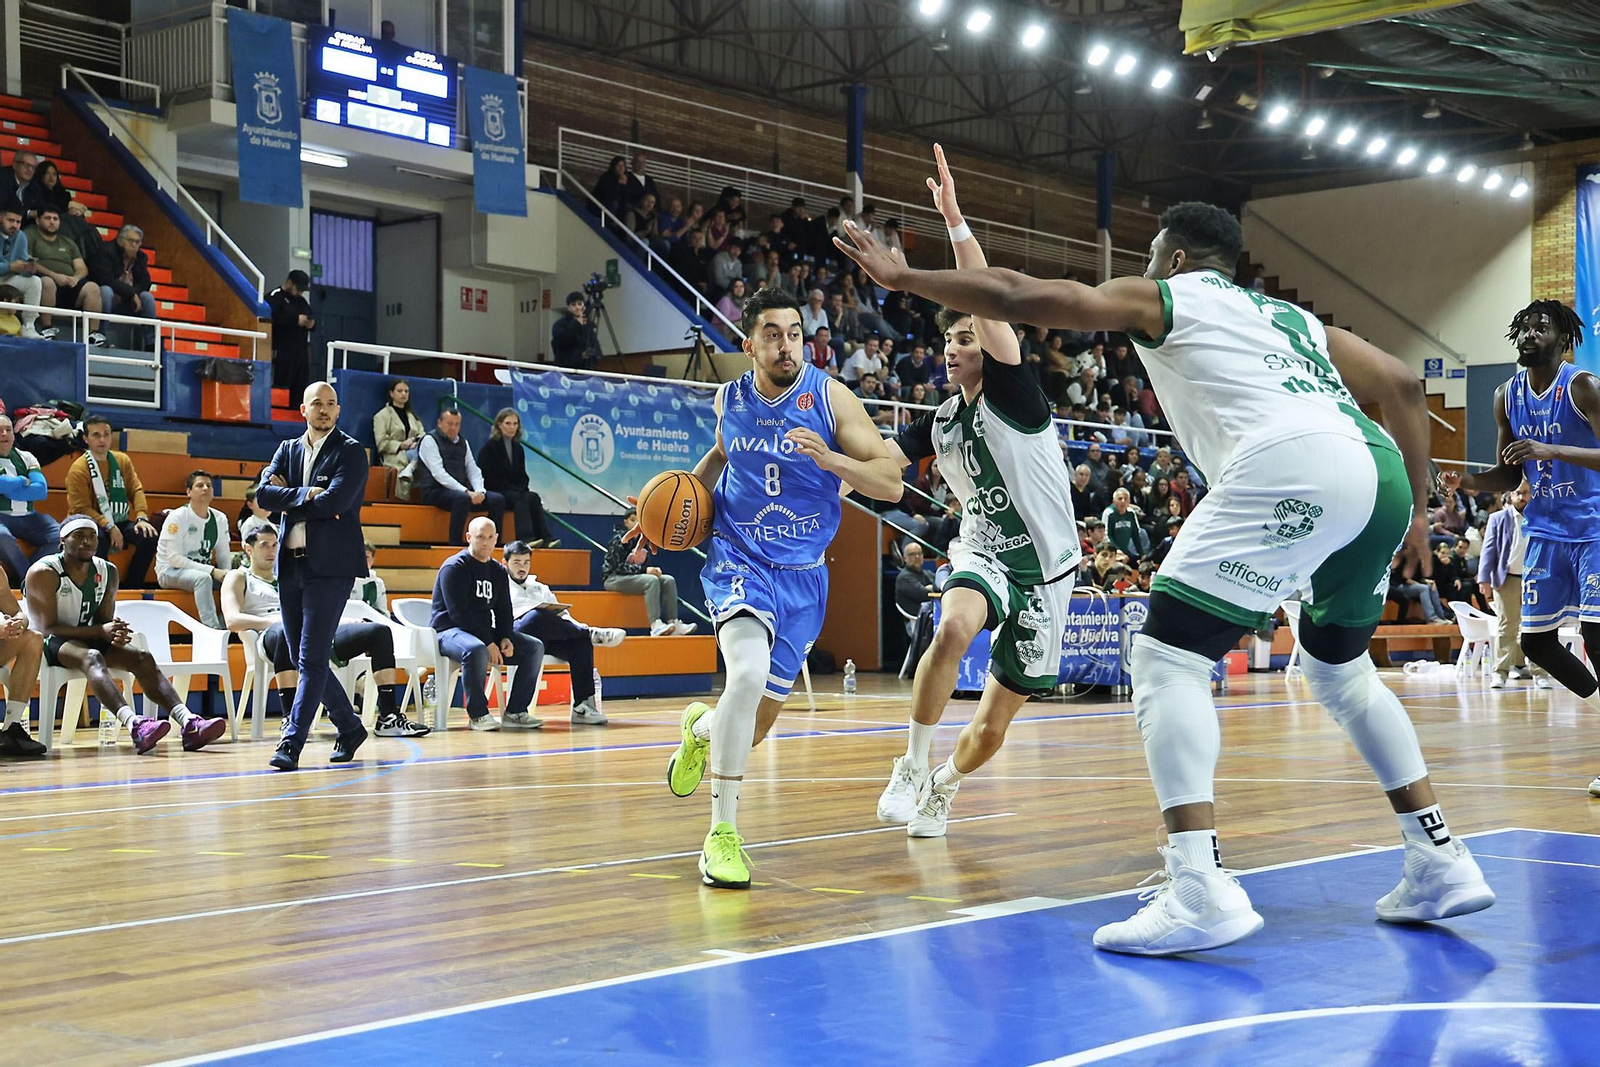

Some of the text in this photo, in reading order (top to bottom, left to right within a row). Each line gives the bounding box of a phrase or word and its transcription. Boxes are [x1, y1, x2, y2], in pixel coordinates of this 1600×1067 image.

[242, 123, 297, 140] Ayuntamiento
[250, 135, 291, 150] de Huelva
[474, 141, 519, 155] Ayuntamiento
[490, 152, 514, 163] Huelva
[520, 299, 537, 313] 117
[756, 418, 785, 427] Huelva
[615, 424, 689, 440] Ayuntamiento
[636, 439, 689, 453] de Huelva
[764, 463, 781, 497] 8
[670, 498, 693, 546] Wilson
[1219, 560, 1283, 592] efficold
[1065, 611, 1119, 626] ntamiento
[1063, 628, 1118, 643] de Huelva
